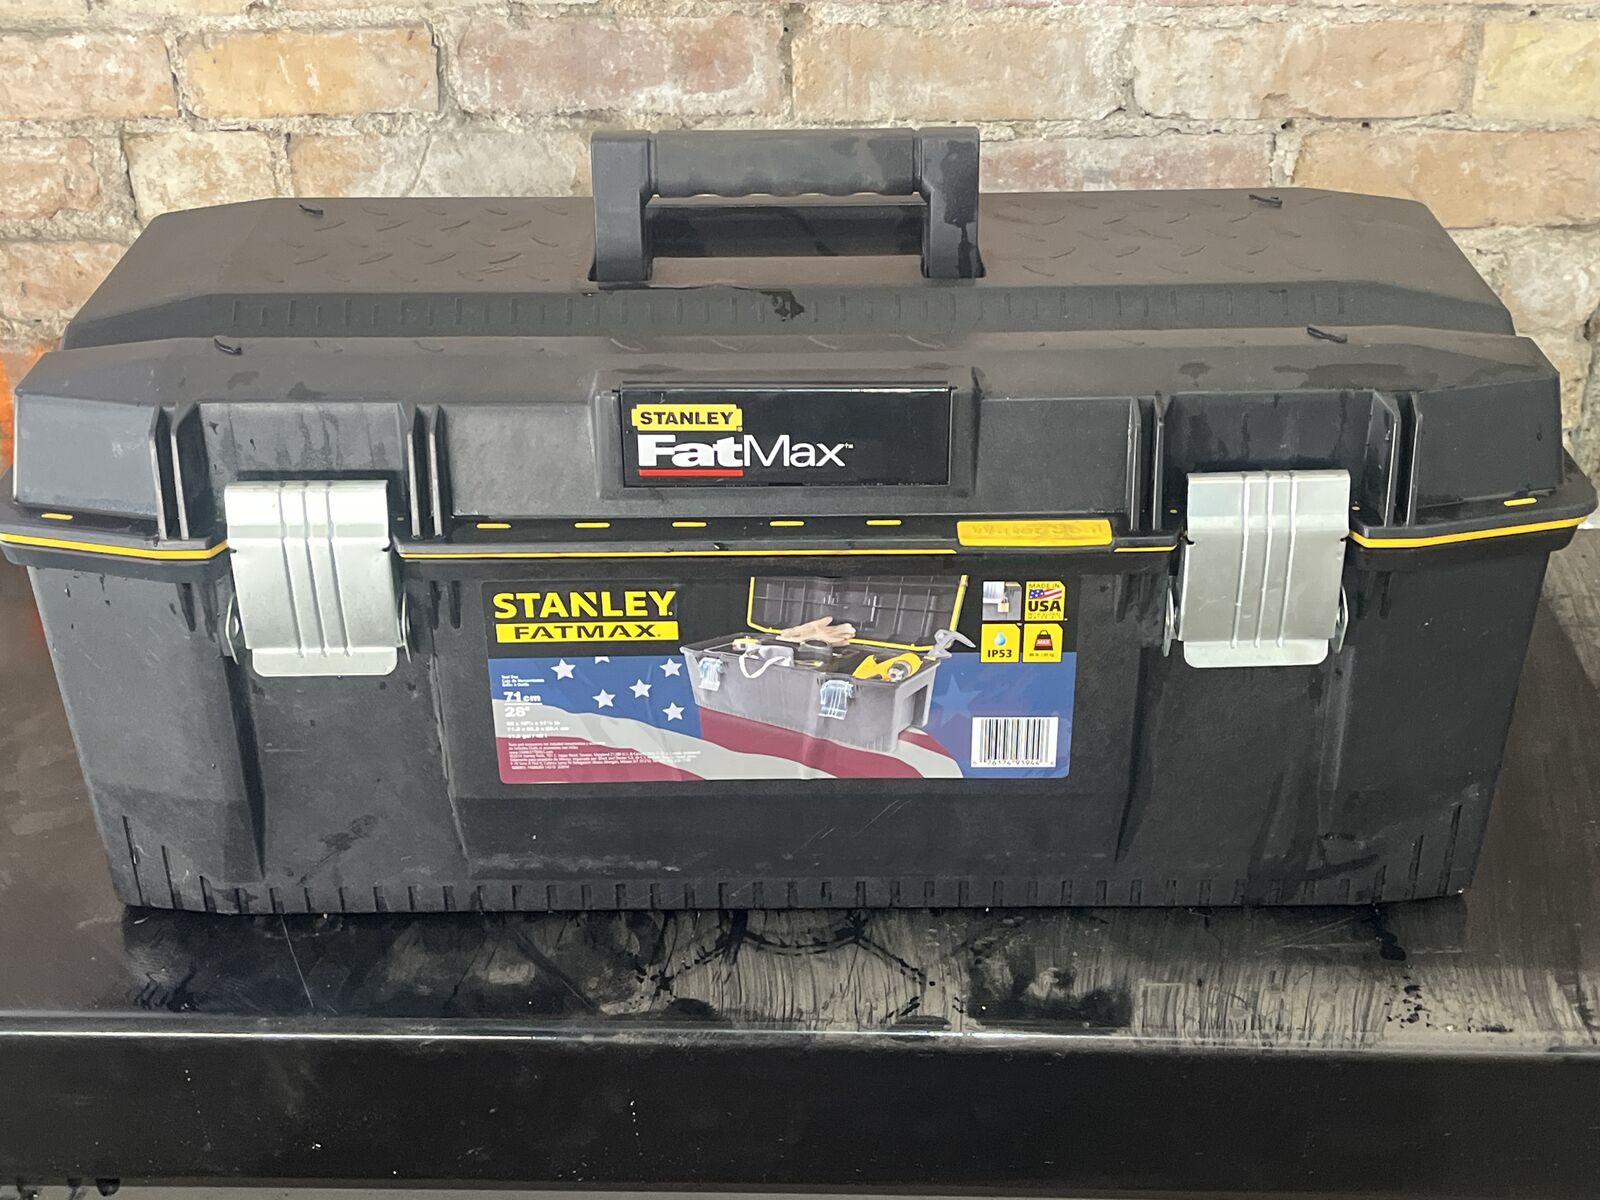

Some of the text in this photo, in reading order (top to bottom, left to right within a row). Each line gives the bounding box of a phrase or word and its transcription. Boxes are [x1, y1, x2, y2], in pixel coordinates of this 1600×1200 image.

[640, 411, 734, 426] STANLEY
[492, 590, 677, 618] STANLEY
[1028, 600, 1061, 612] USA
[513, 624, 656, 640] FATMAX
[987, 649, 1013, 658] IP53
[503, 691, 521, 702] 71
